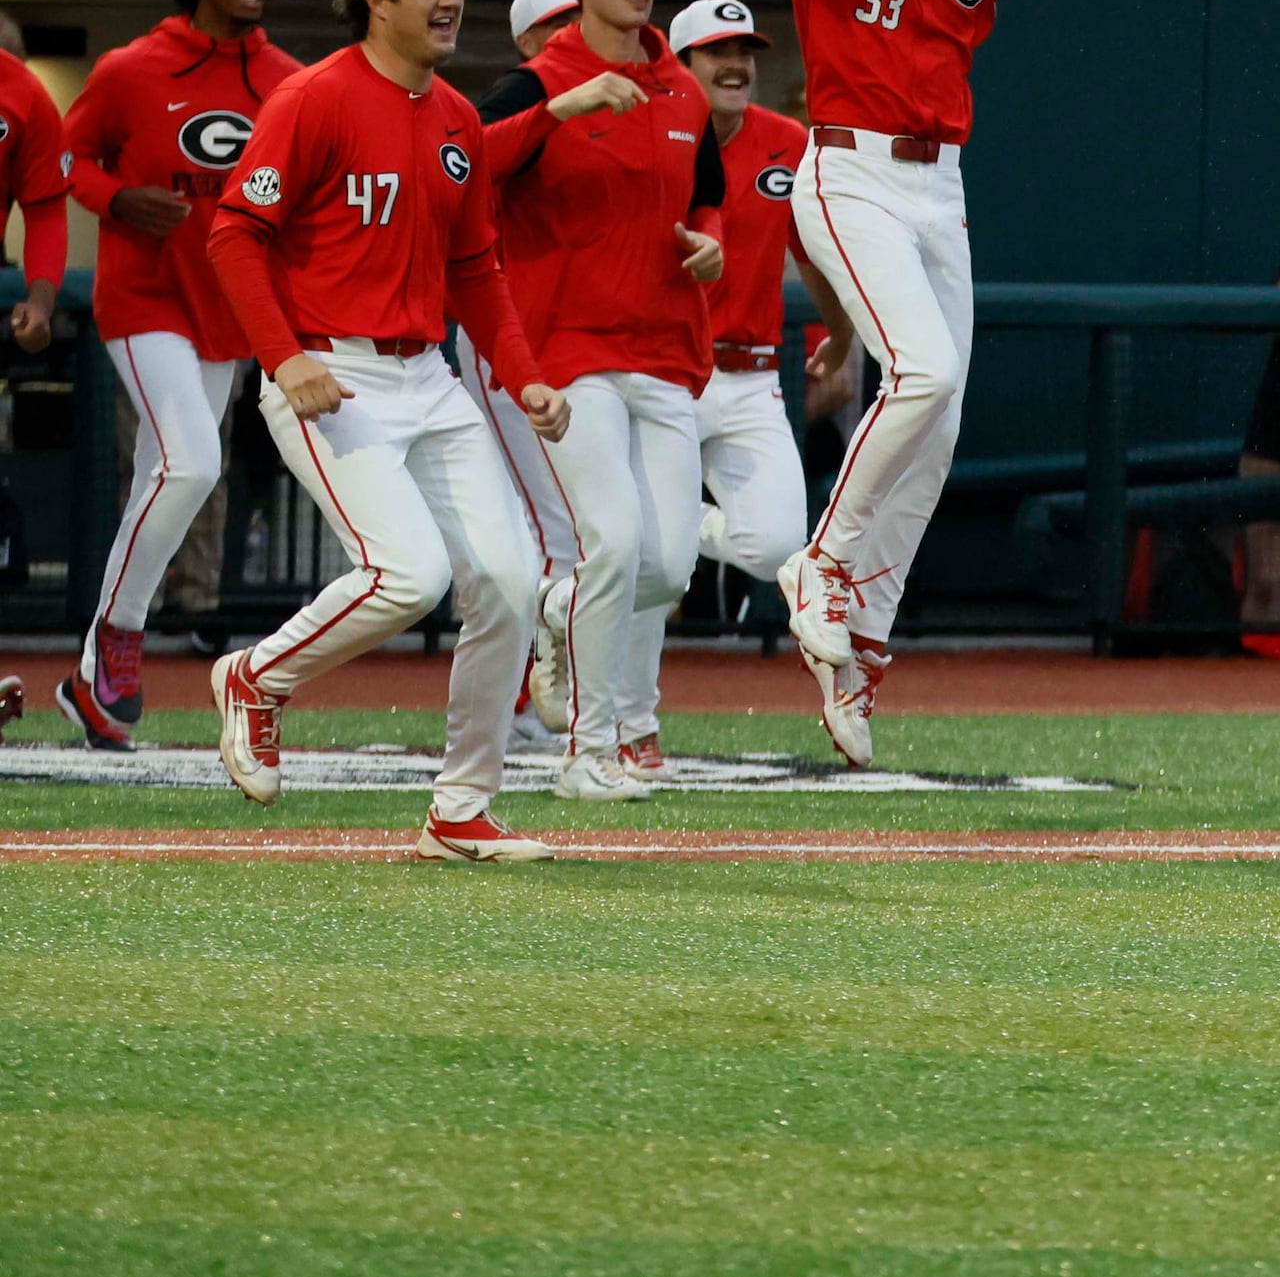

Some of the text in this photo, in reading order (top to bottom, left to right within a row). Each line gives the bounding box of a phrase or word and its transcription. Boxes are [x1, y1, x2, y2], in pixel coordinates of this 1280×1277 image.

[714, 3, 746, 22] G
[178, 111, 254, 170] G
[251, 168, 279, 196] SEC
[439, 143, 470, 184] G
[347, 173, 400, 225] 47
[755, 165, 797, 201] G
